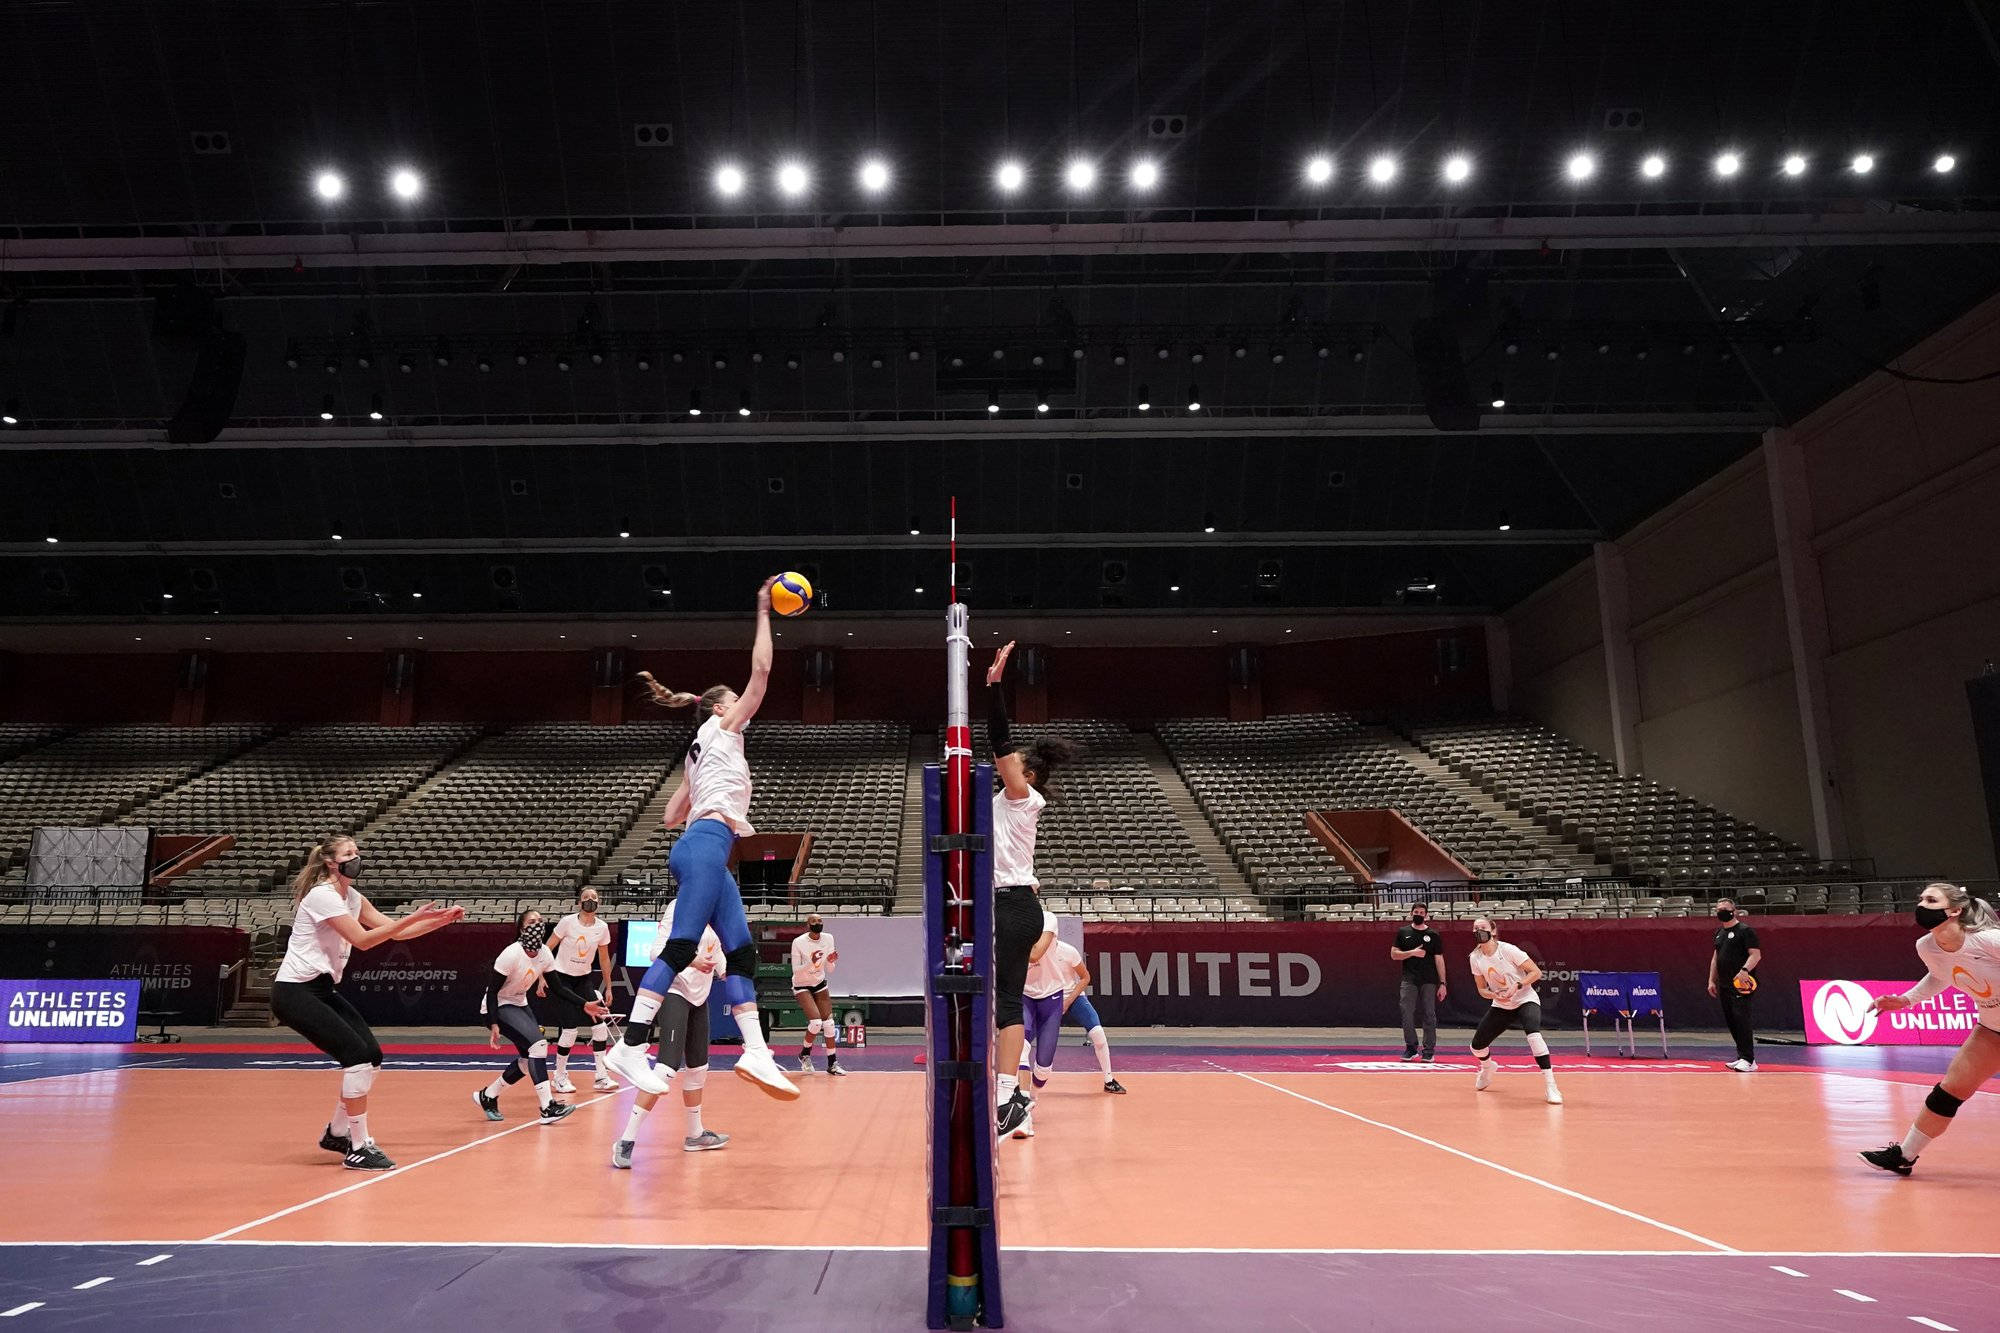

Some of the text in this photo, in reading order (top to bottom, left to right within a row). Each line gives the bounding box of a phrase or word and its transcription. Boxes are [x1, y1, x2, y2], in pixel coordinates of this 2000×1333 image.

[110, 964, 192, 976] ATHLETES
[352, 970, 458, 981] @AUPROSPORTS
[1086, 952, 1322, 997] IMITED
[9, 991, 126, 1008] ATHLETES
[8, 1010, 125, 1027] UNLIMITED
